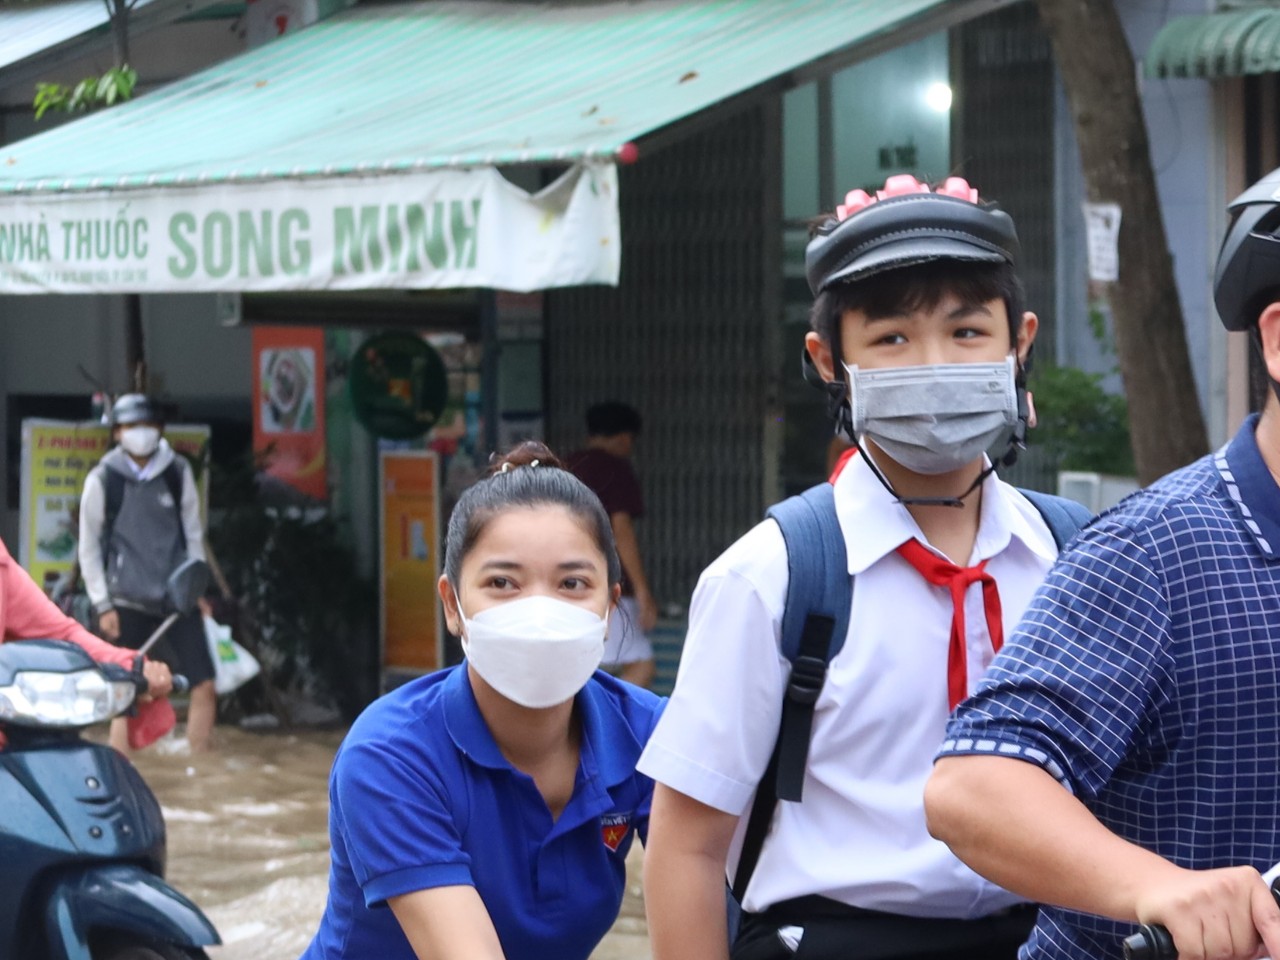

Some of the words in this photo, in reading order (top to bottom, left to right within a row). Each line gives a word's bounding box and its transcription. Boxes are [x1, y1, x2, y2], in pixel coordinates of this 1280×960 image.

[0, 212, 51, 262] NHÀ
[61, 200, 148, 260] THUỐC
[167, 208, 311, 279] SONG
[333, 198, 482, 275] MINH
